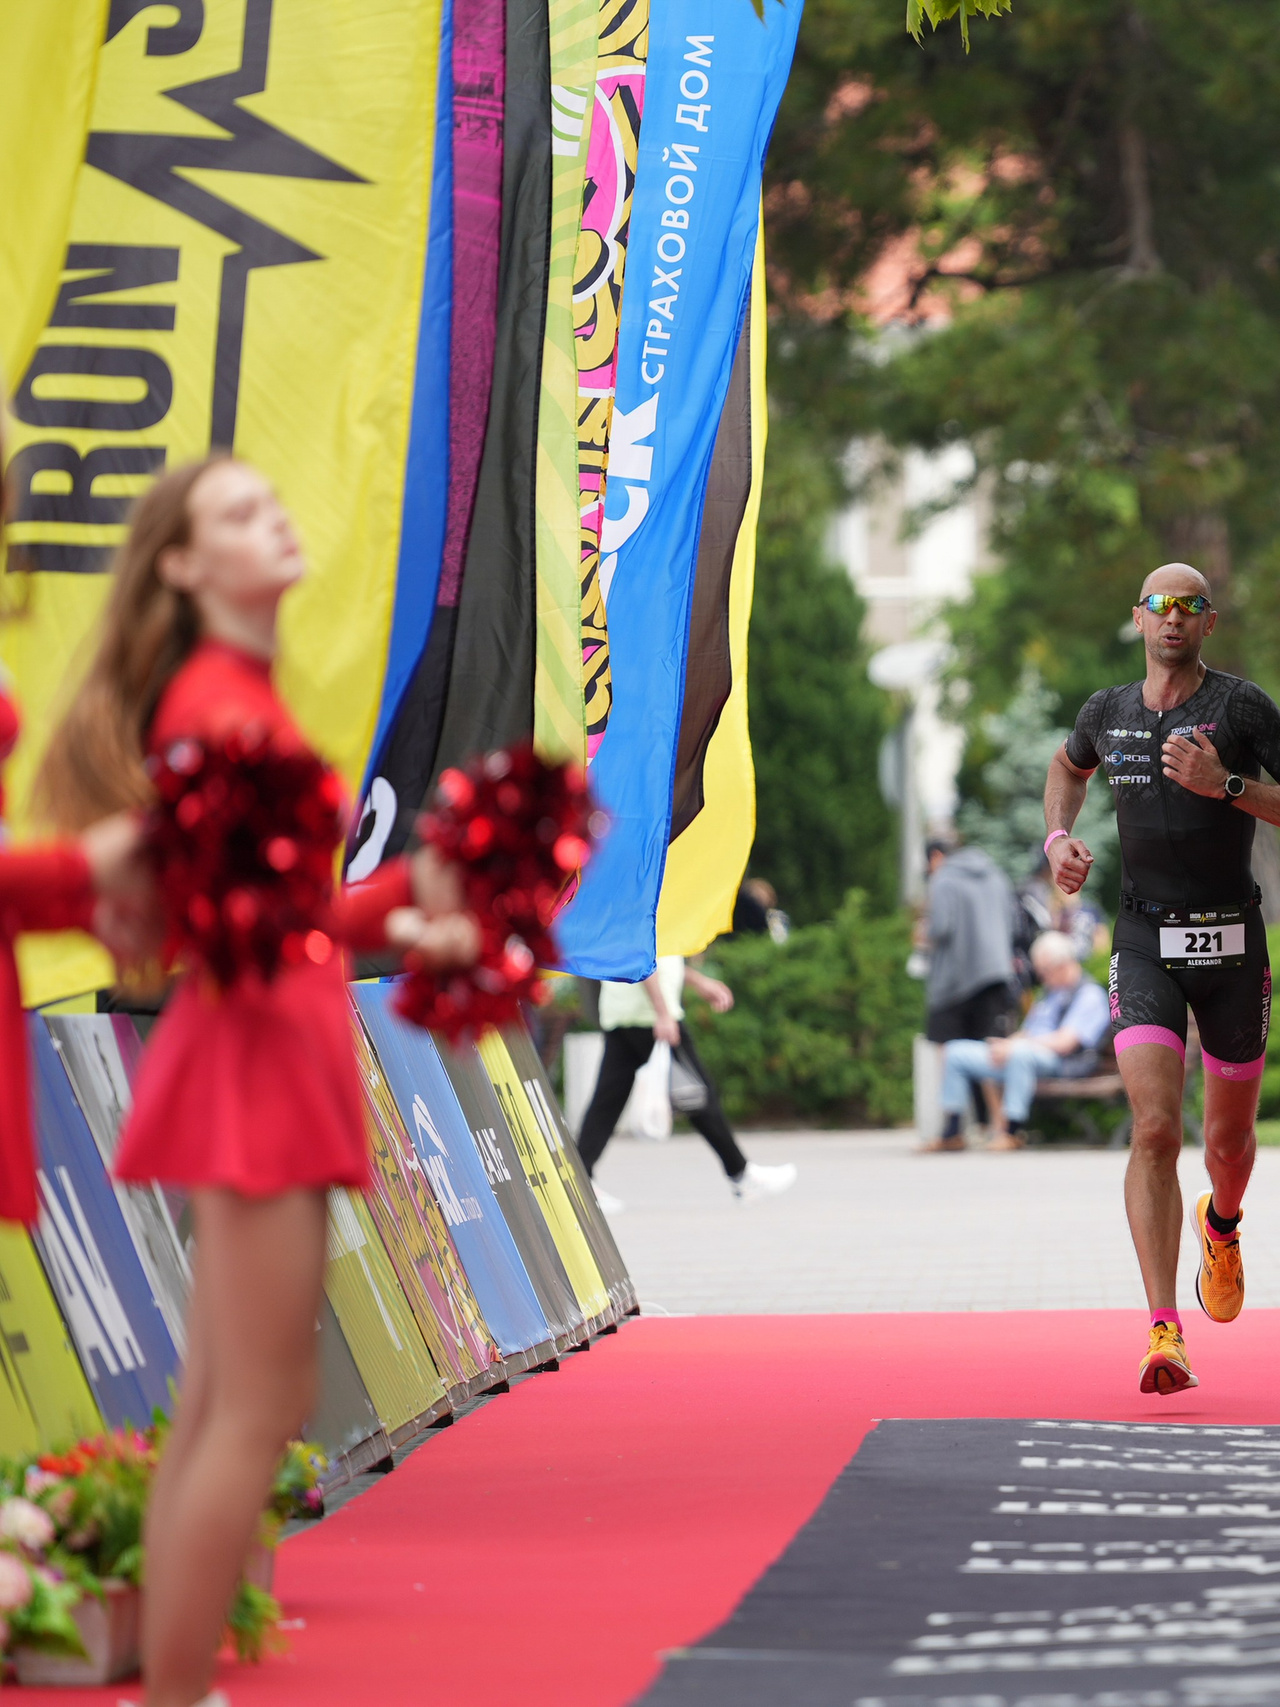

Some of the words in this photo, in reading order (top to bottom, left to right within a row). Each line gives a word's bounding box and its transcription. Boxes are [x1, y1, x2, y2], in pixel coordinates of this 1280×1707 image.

[641, 142, 701, 385] СТРАХОВОЙ
[675, 35, 715, 133] ДОМ
[3, 240, 181, 574] IRON
[1184, 931, 1223, 953] 221
[1187, 958, 1223, 967] ALEKSANDR
